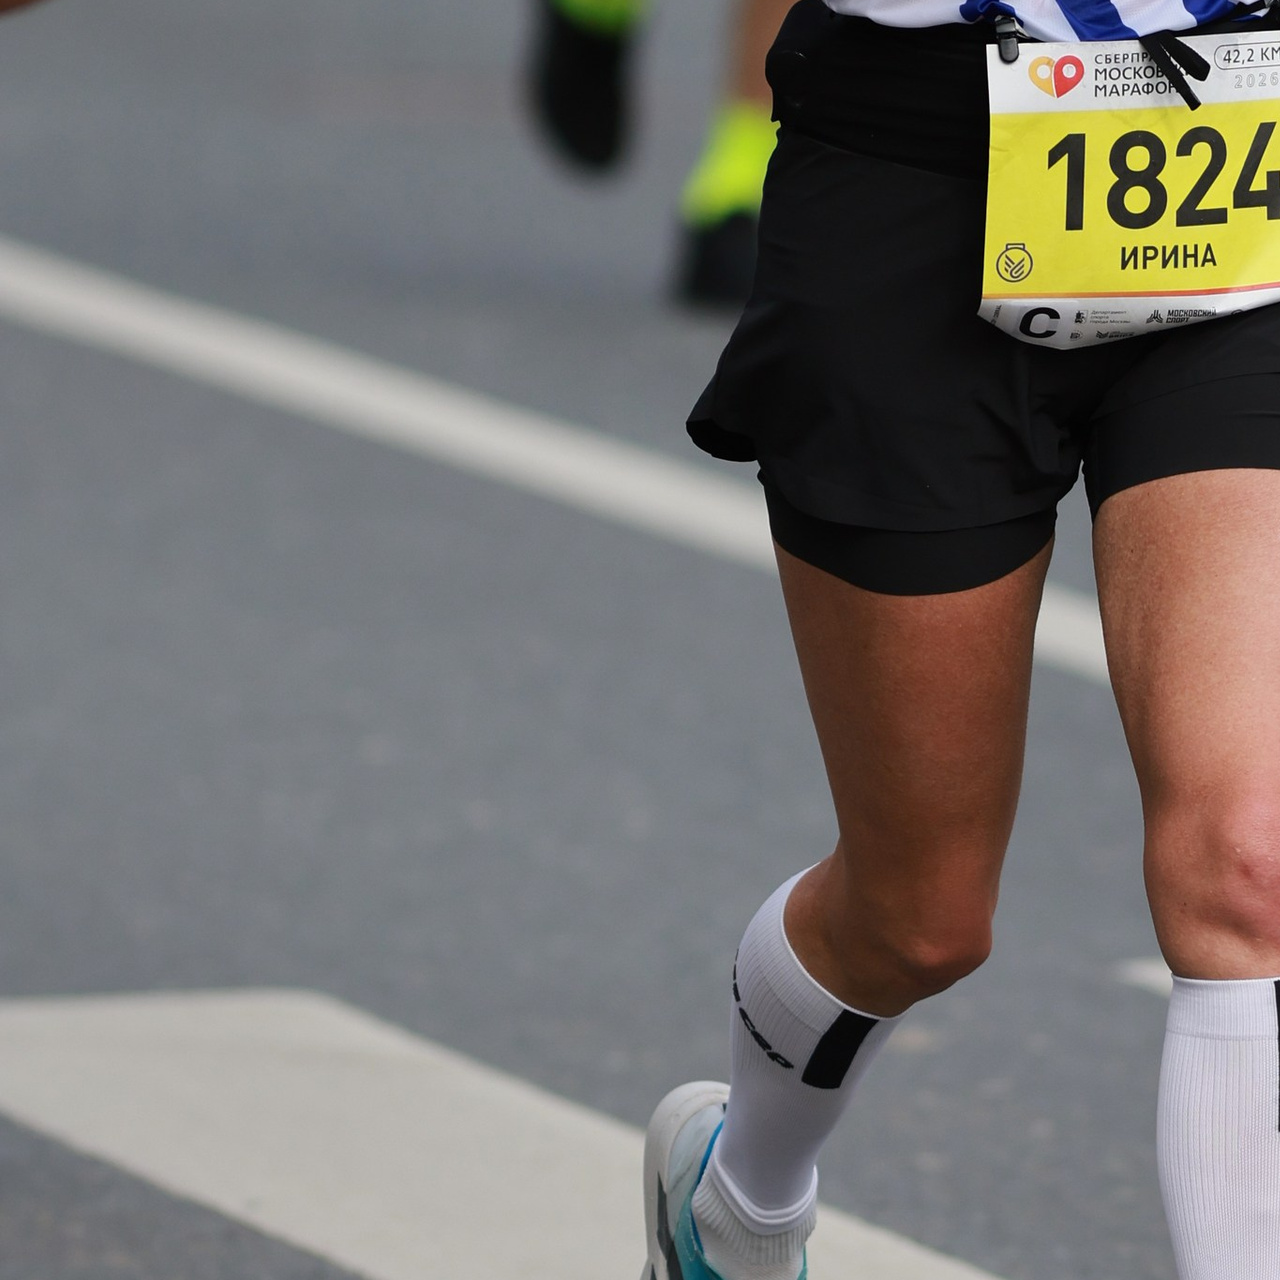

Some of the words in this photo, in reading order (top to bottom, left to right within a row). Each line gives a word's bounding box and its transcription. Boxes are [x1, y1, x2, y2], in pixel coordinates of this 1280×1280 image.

[1094, 51, 1153, 65] СБЕРПР
[1223, 48, 1254, 65] 42,2
[1094, 64, 1187, 81] МОСКОВ
[1234, 71, 1279, 89] 2026
[1120, 243, 1217, 271] ИРИНА
